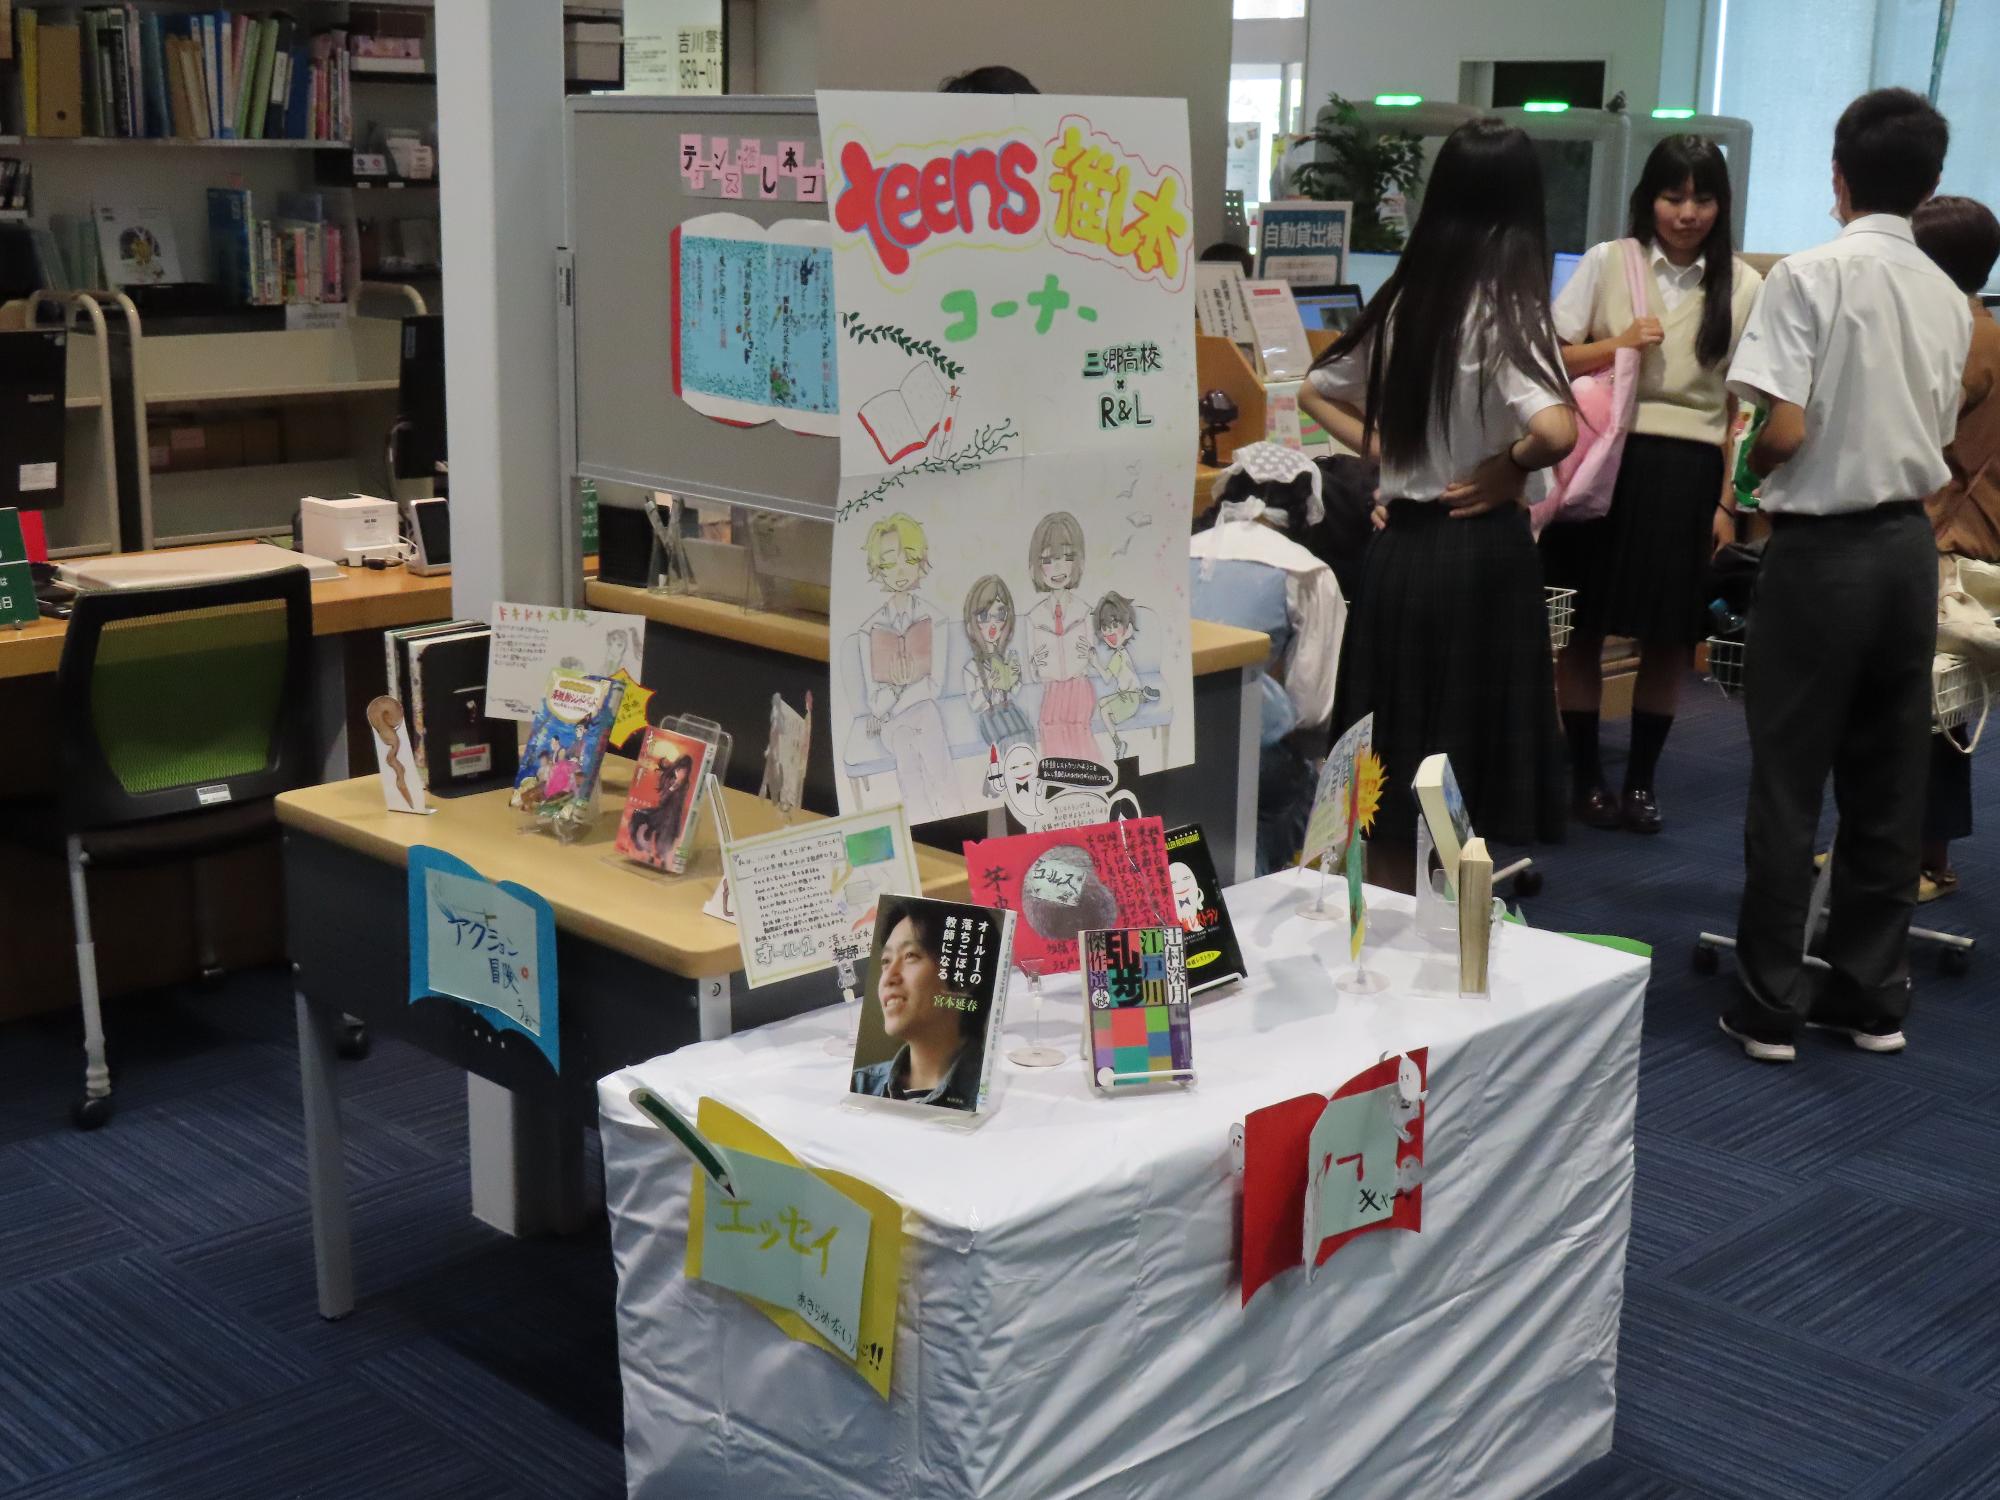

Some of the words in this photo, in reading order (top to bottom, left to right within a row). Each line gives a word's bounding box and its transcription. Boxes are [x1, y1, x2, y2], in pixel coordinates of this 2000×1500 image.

[678, 30, 723, 53] 吉川警
[680, 58, 722, 89] 958-01
[836, 141, 1040, 275] teens
[1048, 125, 1188, 281] 推し本
[1264, 223, 1344, 249] 自動貸出機
[941, 274, 1099, 342] コーナー
[1083, 343, 1162, 377] 三郷高校
[1100, 394, 1152, 428] R&L
[447, 914, 519, 958] アクション
[937, 915, 957, 981] 教師になる
[953, 918, 974, 988] 落ちこぼれ、
[969, 920, 990, 985] オール1の
[1087, 931, 1109, 990] 傑作選
[1164, 928, 1189, 1005] 辻村深月
[488, 957, 520, 995] 冒険
[1106, 931, 1144, 1008] 乱歩
[1139, 930, 1168, 1005] 江戸川
[932, 994, 979, 1013] 宮本延春
[715, 1199, 841, 1278] エッセイ
